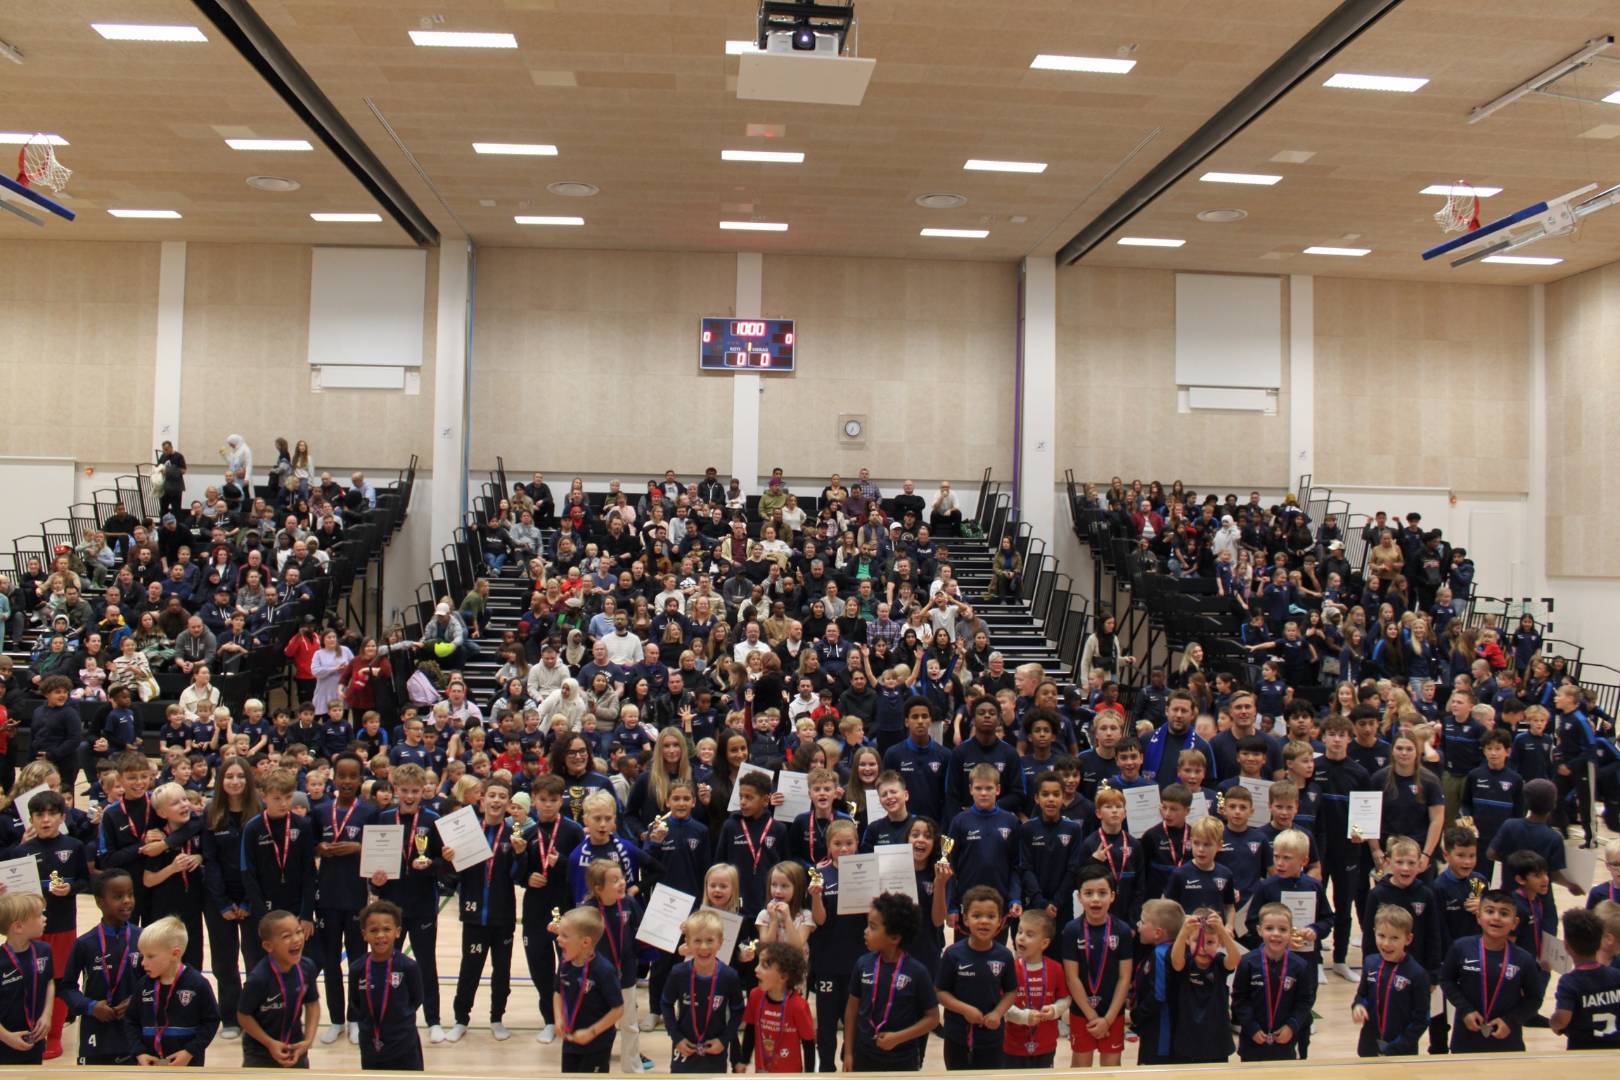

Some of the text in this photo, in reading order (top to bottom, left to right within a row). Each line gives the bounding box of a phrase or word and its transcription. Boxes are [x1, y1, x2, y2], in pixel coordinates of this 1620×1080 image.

[703, 332, 711, 343] 0
[785, 333, 793, 345] 0
[737, 352, 746, 366] 0
[761, 353, 769, 366] 0
[465, 901, 477, 911] 24
[470, 944, 482, 953] 24
[819, 980, 833, 992] 22
[88, 1033, 97, 1047] 4
